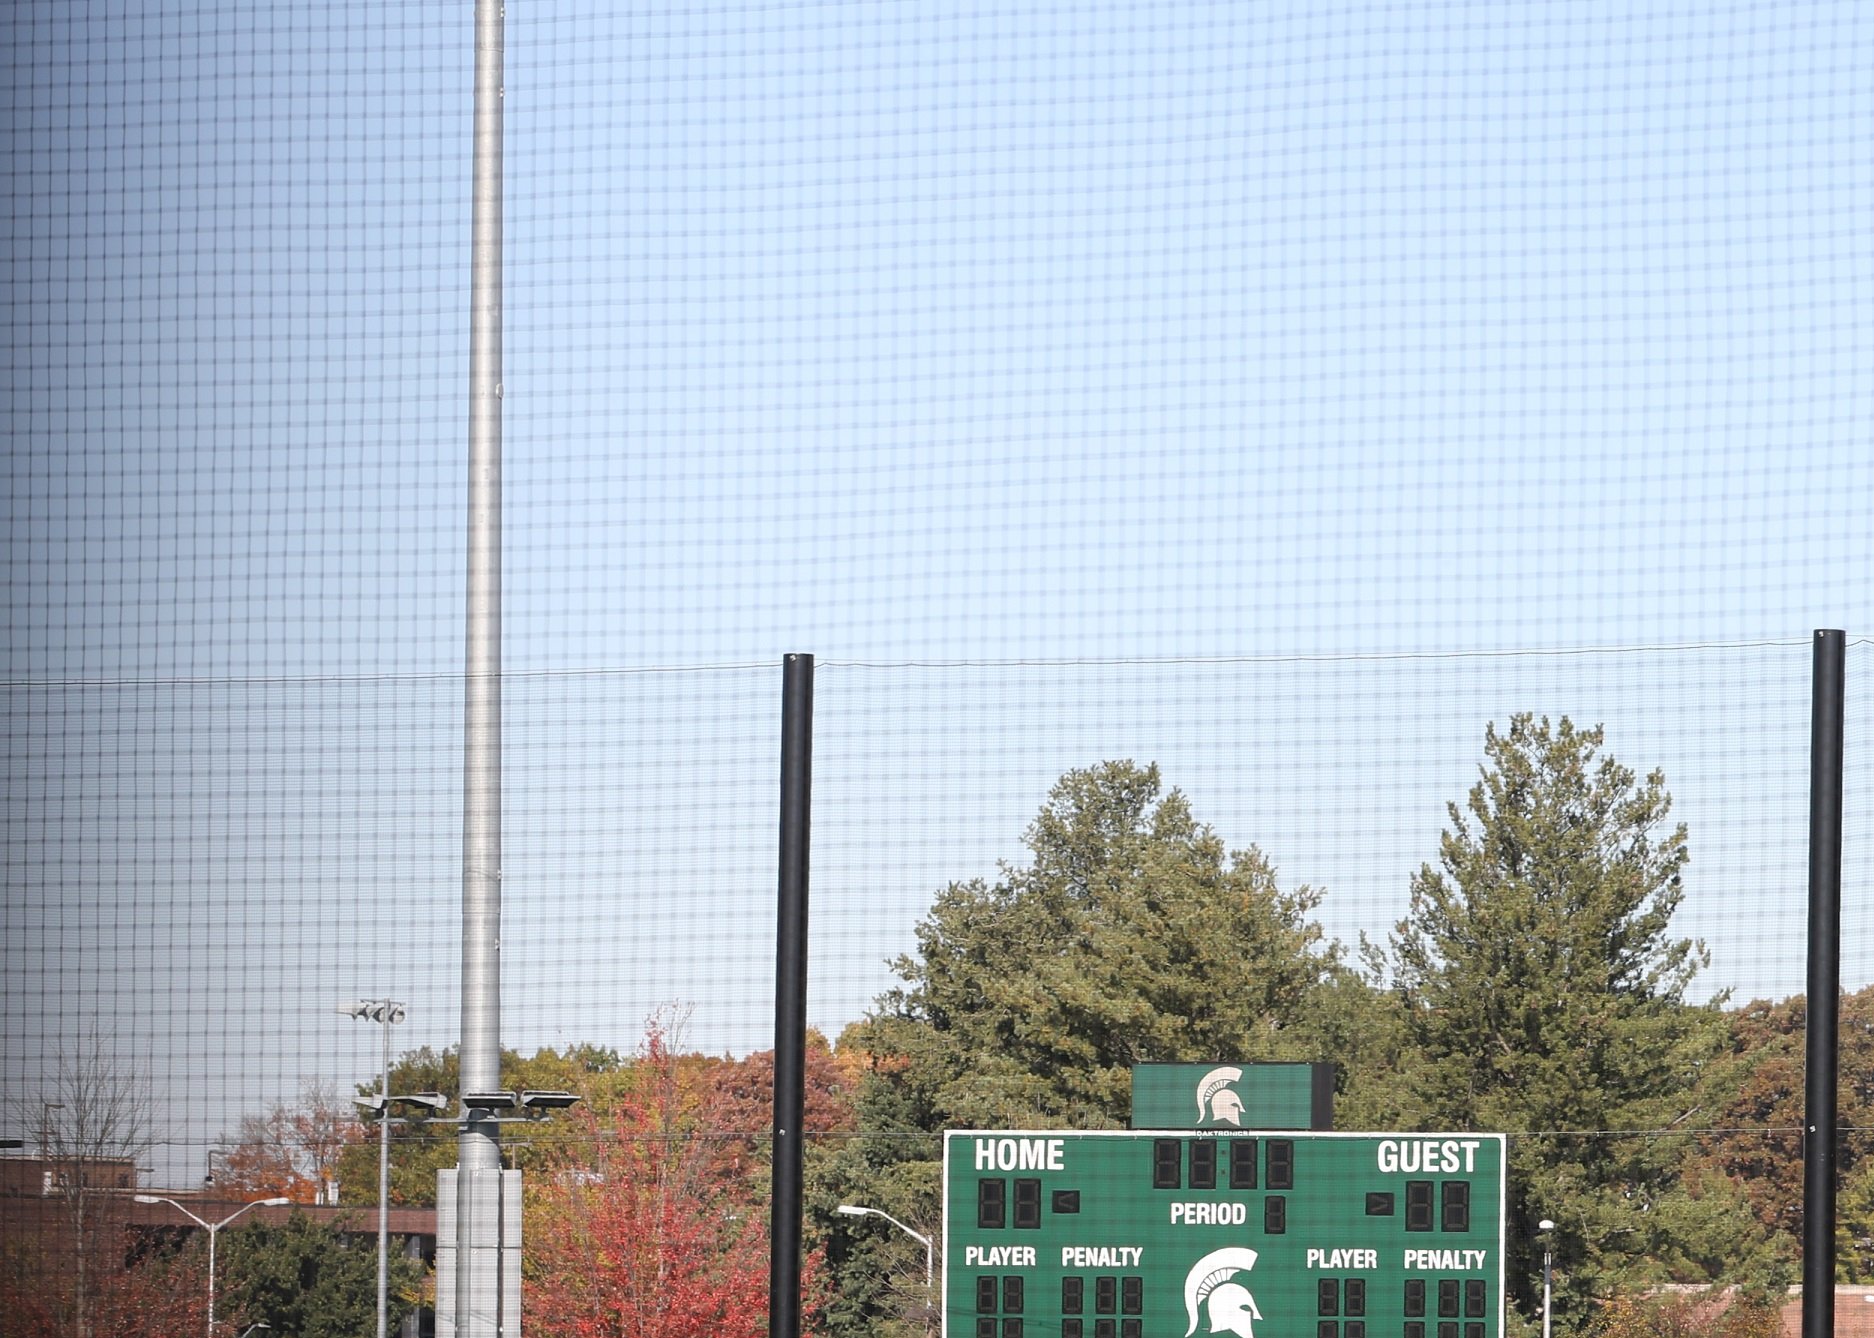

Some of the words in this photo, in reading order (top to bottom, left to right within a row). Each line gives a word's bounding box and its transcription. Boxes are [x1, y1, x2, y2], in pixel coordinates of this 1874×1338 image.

[976, 1139, 1064, 1170] HOME
[1378, 1140, 1479, 1172] GUEST
[1171, 1203, 1246, 1225] PERIOD
[966, 1246, 1035, 1266] PLAYER
[1062, 1247, 1143, 1267] PENALTY
[1307, 1249, 1377, 1268] PLAYER
[1404, 1250, 1486, 1269] PENALTY
